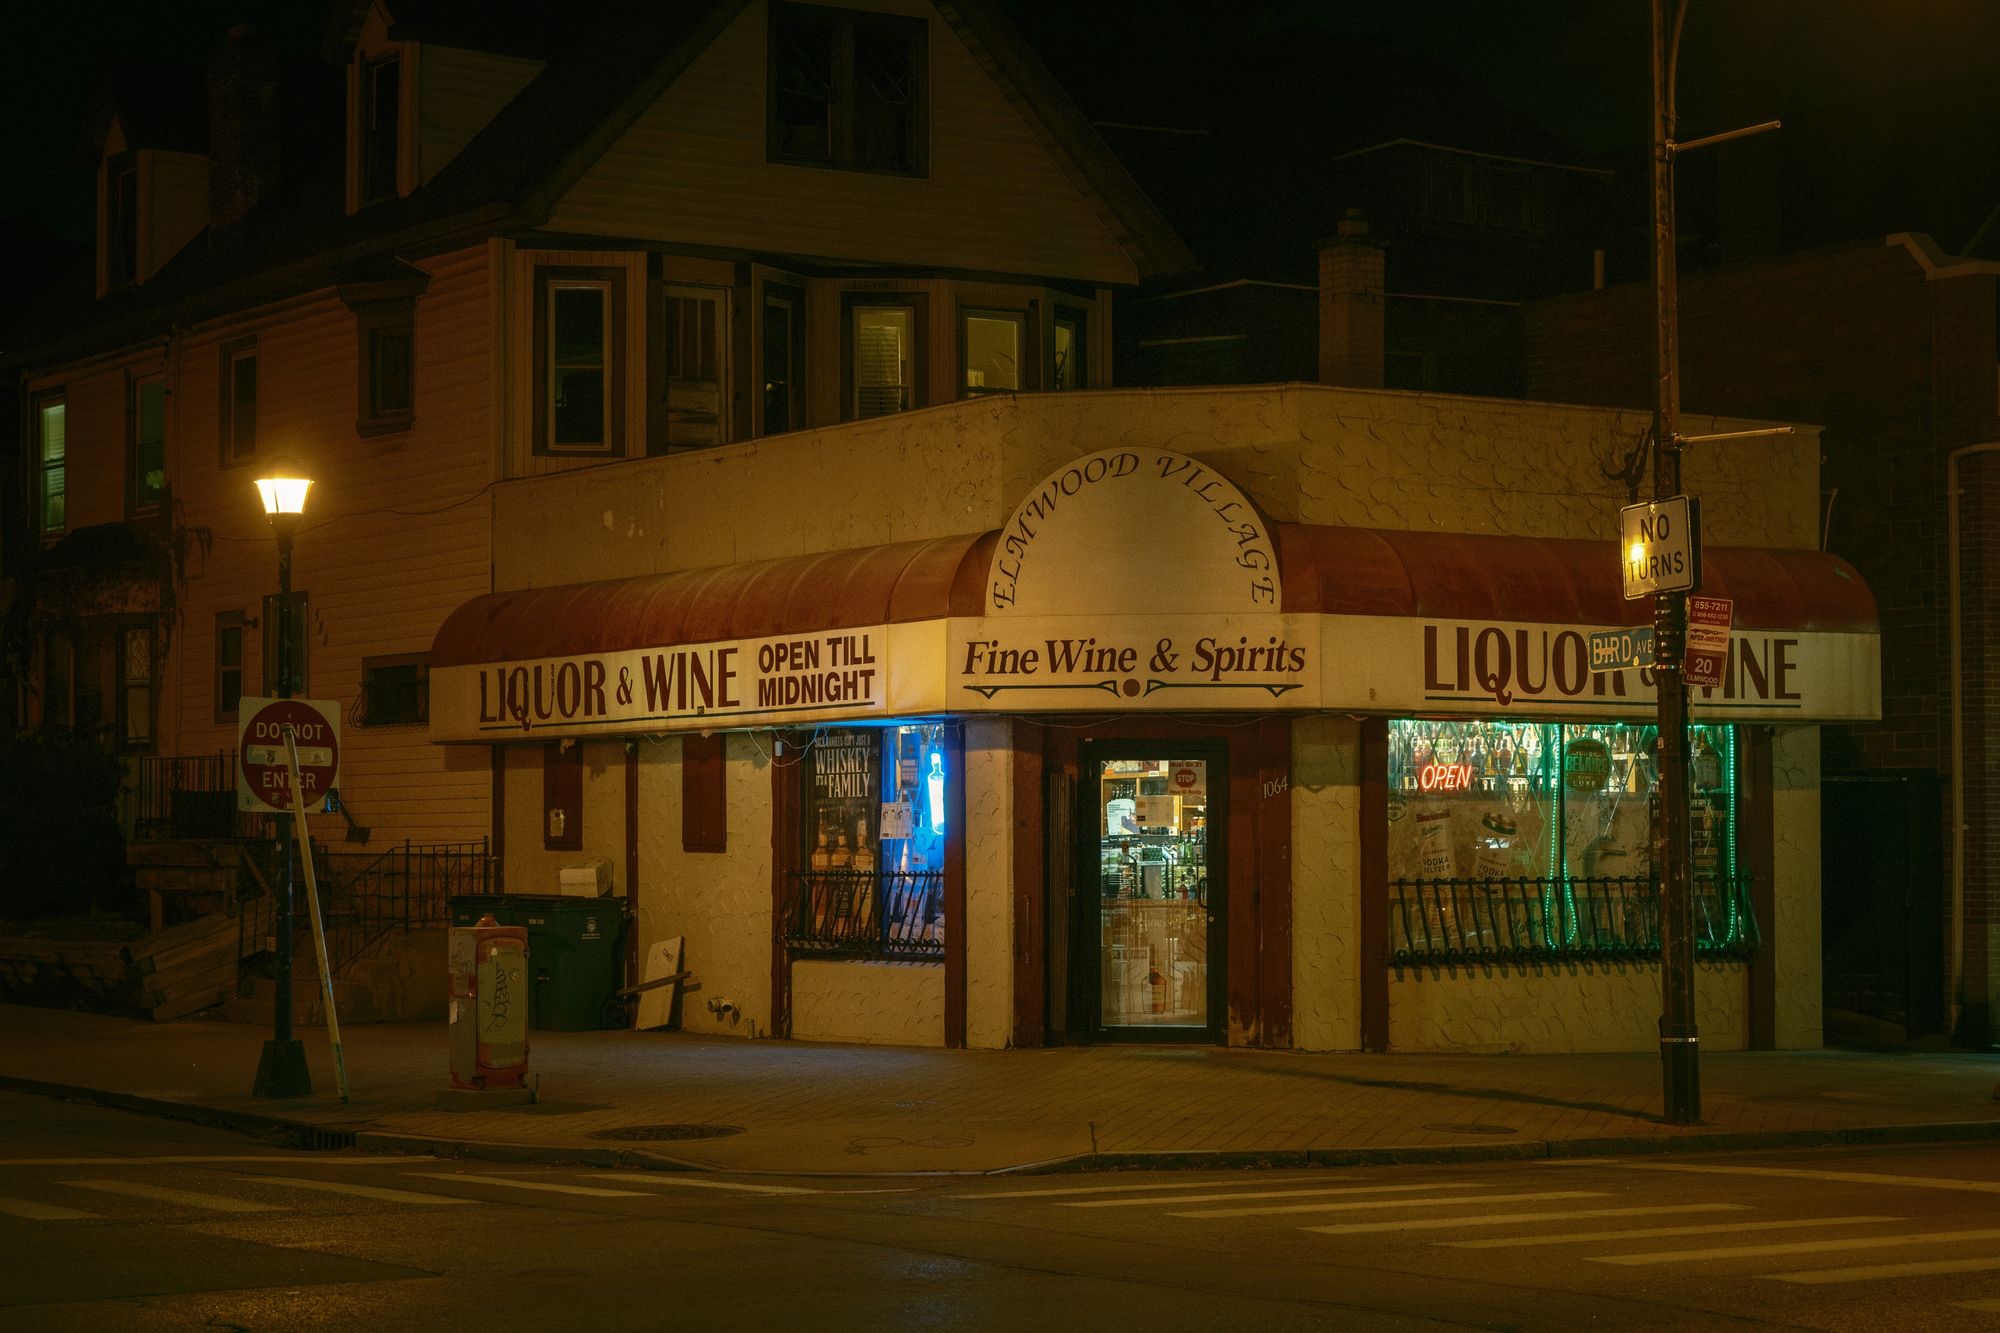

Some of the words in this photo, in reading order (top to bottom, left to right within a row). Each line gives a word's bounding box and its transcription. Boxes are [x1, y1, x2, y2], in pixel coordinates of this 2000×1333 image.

[993, 453, 1140, 610] ELMWOOD
[1156, 455, 1275, 605] VILLAGE
[1640, 514, 1670, 544] NO
[1628, 551, 1684, 582] TURNS
[1694, 601, 1728, 611] 855-7211
[758, 640, 820, 673] OPEN
[826, 635, 875, 667] TILL
[962, 640, 1038, 675] Fine
[1045, 638, 1136, 674] Wine
[1150, 638, 1179, 673] &
[1191, 637, 1305, 681] Spirits
[1593, 635, 1632, 666] BIRD
[1636, 639, 1653, 655] AVE
[1694, 658, 1713, 674] 20
[480, 660, 606, 731] LIQUOR
[616, 666, 634, 706] &
[641, 648, 740, 711] WINE
[758, 670, 875, 707] MIDNIGHT
[1686, 674, 1719, 684] ELMWOOD
[256, 722, 280, 738] DO
[290, 724, 324, 740] NOT
[815, 747, 870, 774] WHISKEY
[828, 773, 871, 798] FAMILY
[1177, 774, 1195, 783] STOP
[1263, 775, 1289, 799] 1064
[1422, 765, 1473, 790] OPEN
[1423, 856, 1449, 866] VODKA
[1479, 864, 1504, 877] VODKA
